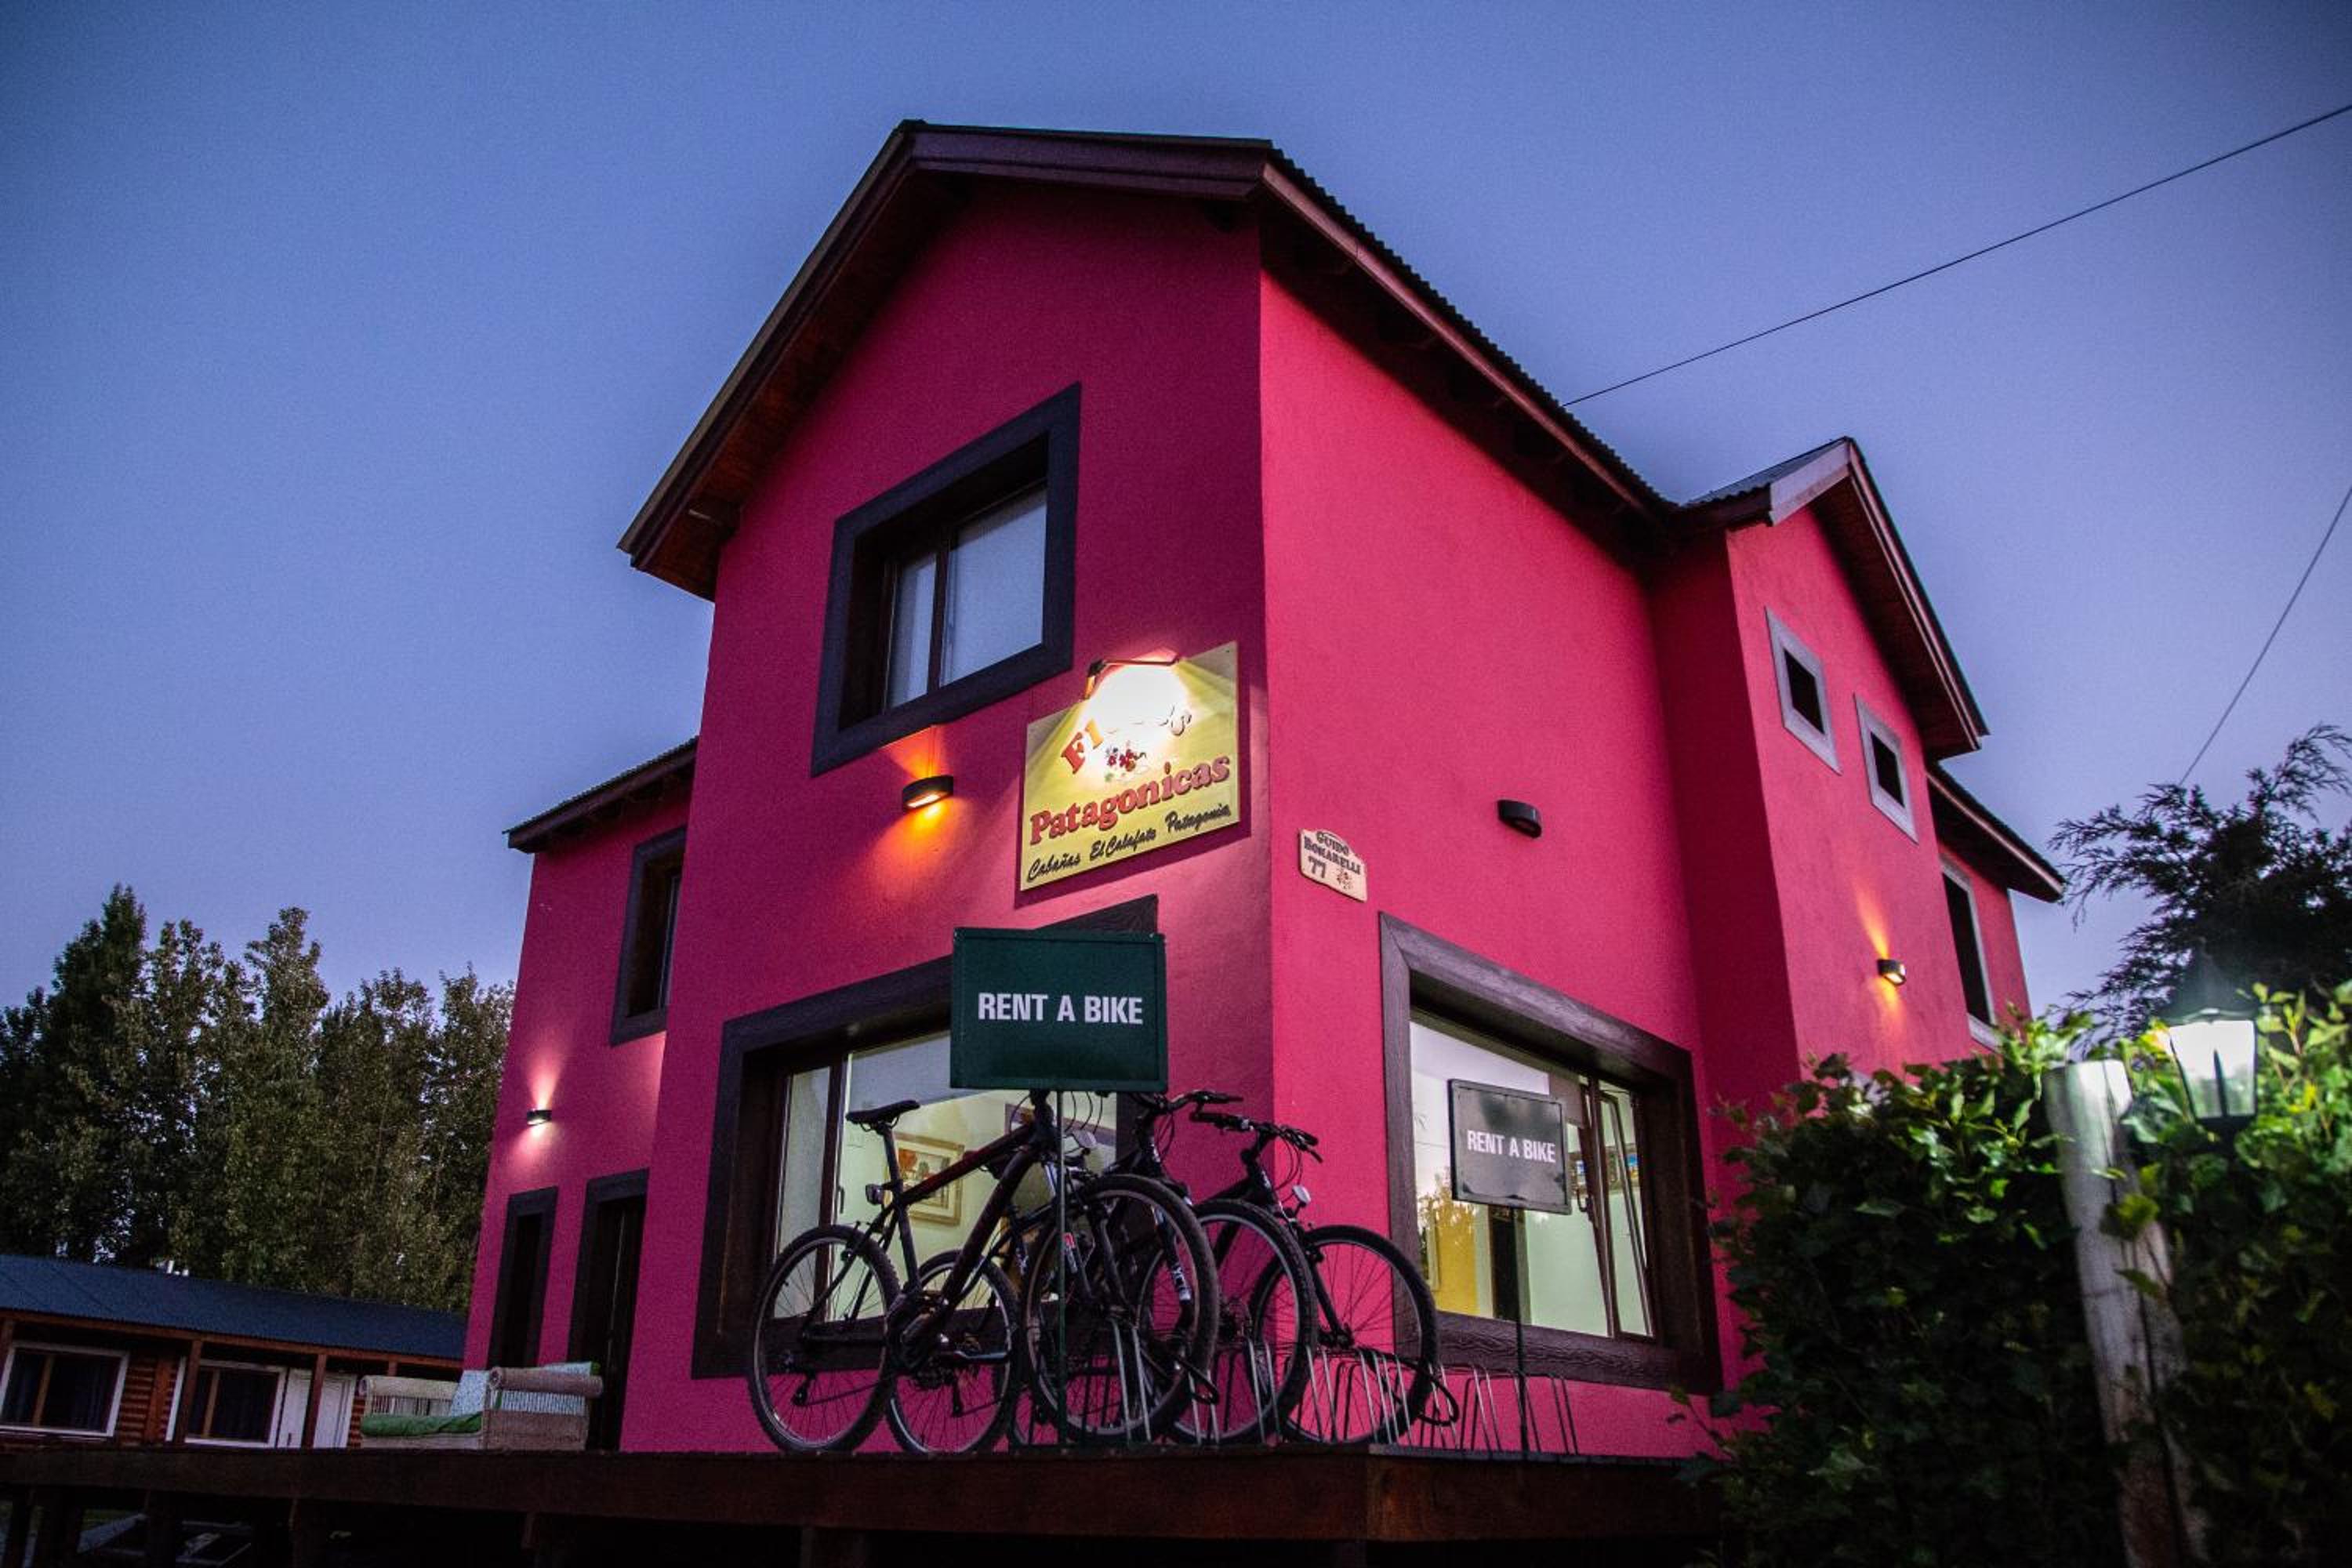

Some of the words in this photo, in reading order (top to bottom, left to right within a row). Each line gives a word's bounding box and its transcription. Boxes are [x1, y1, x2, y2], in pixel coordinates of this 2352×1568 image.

[1029, 756, 1230, 845] Patagonicas
[1026, 852, 1081, 883] Cabañas
[1090, 840, 1105, 862] El
[1105, 828, 1156, 857] Calafate
[1165, 803, 1232, 833] Patagonia
[1308, 856, 1327, 879] 77
[978, 993, 1048, 1020] RENT
[1057, 995, 1076, 1022] A
[1084, 996, 1143, 1025] BIKE
[1467, 1130, 1505, 1155] RENT
[1509, 1138, 1520, 1158] A
[1523, 1139, 1556, 1163] BIKE
